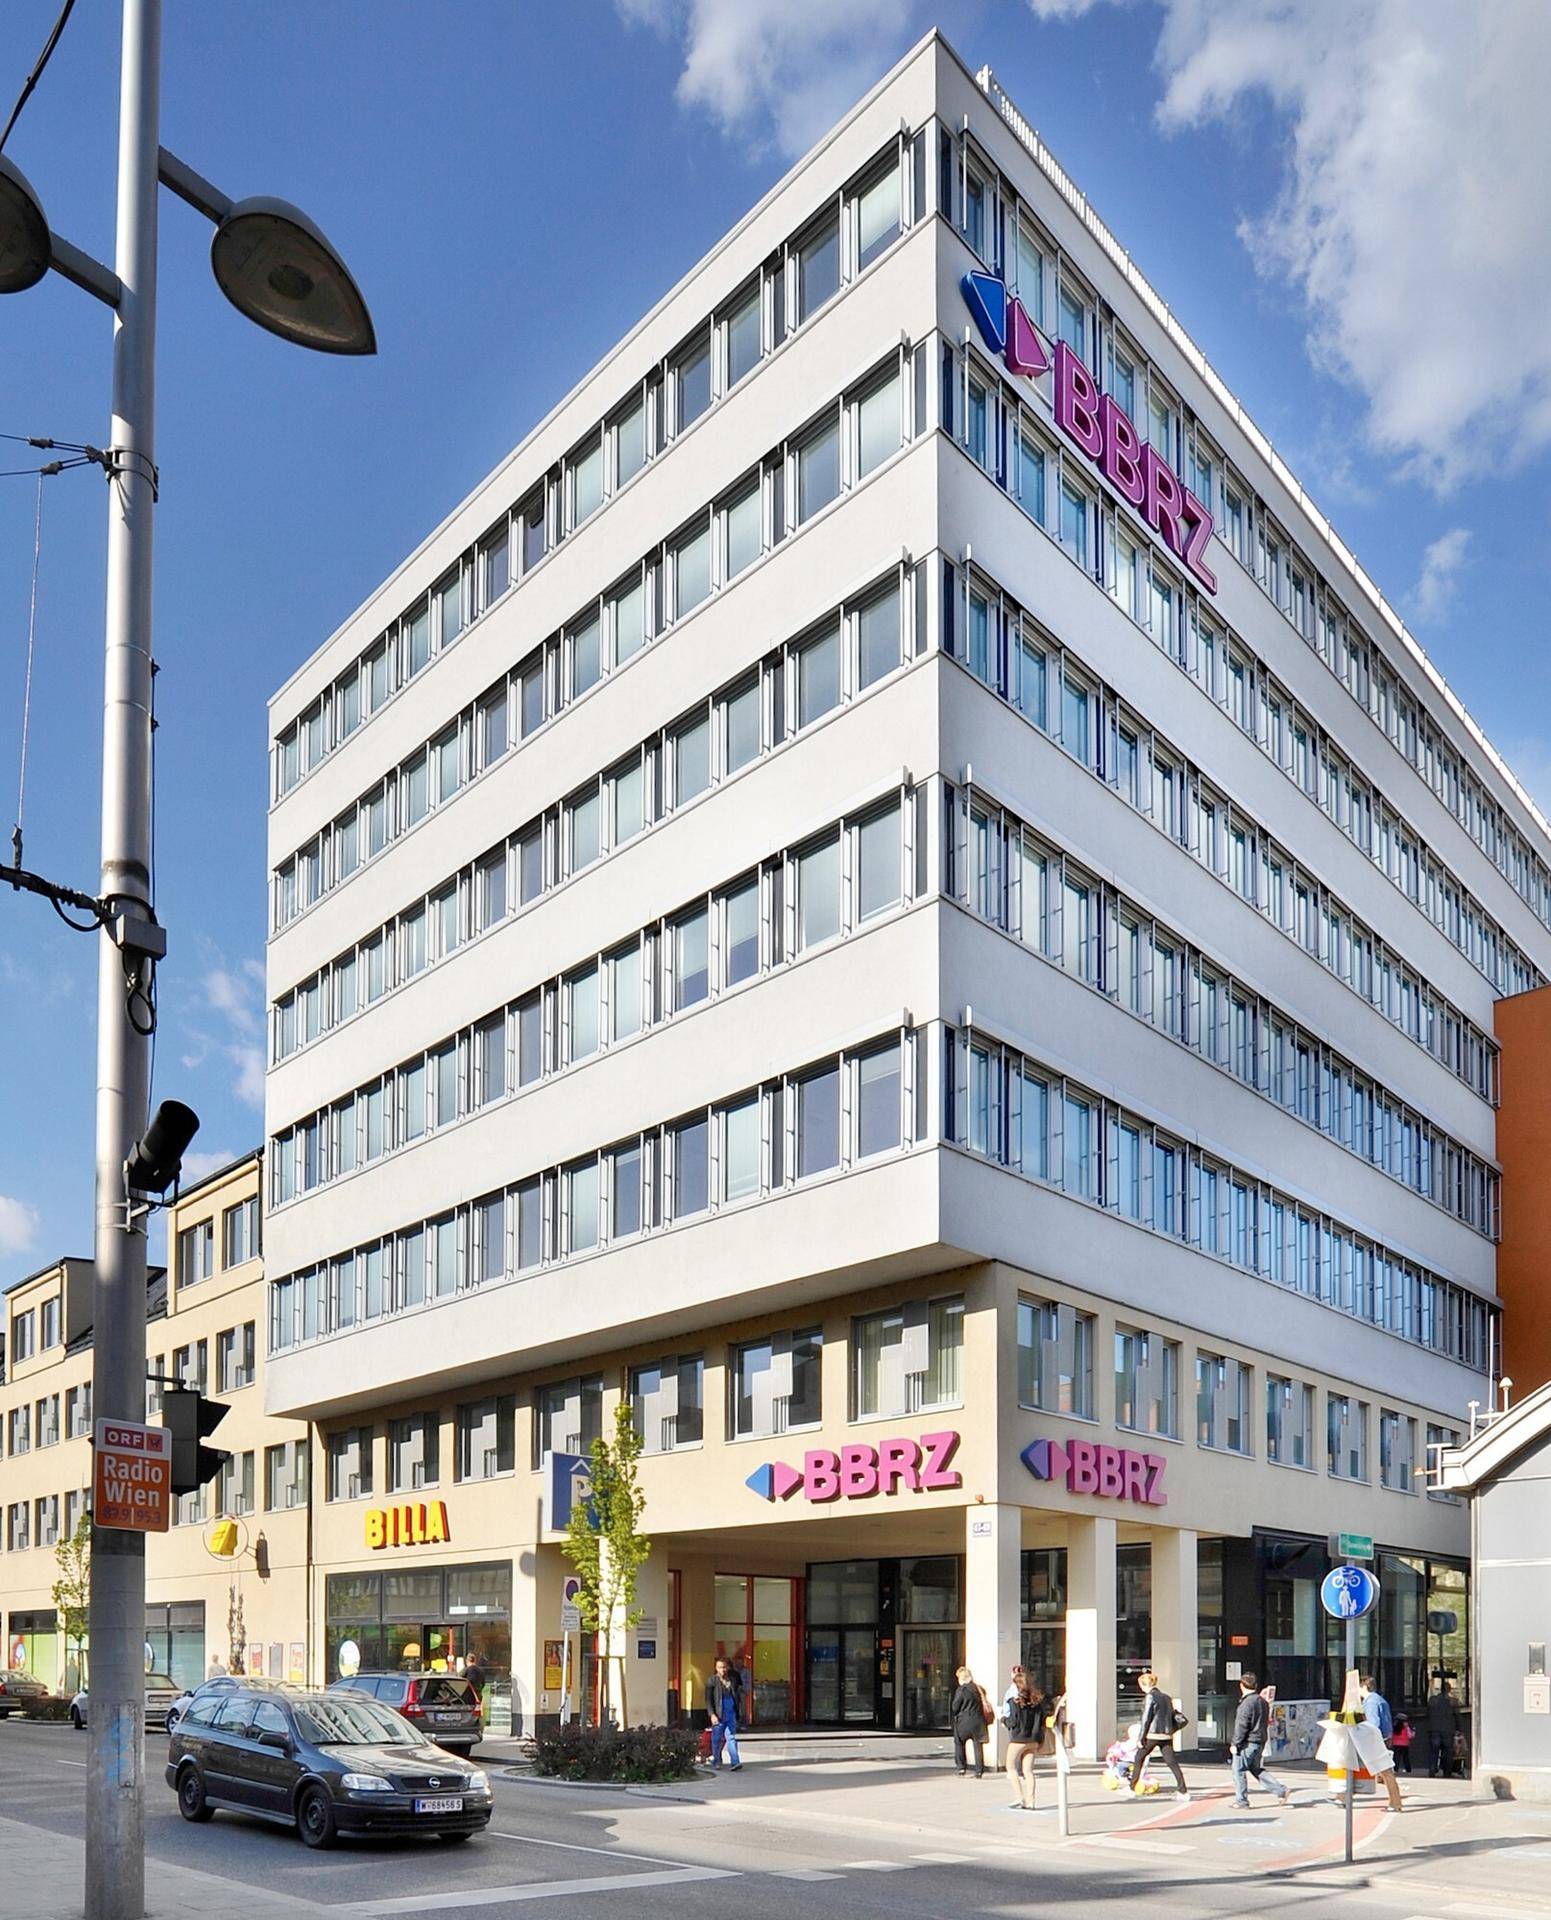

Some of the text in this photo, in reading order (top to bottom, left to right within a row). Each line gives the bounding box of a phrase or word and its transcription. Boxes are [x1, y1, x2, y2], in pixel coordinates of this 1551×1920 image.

[1054, 339, 1218, 596] BBRZ
[107, 1430, 143, 1447] ORF
[103, 1454, 163, 1484] Radio
[804, 1431, 962, 1503] BBRZ
[1066, 1439, 1168, 1506] BBRZ
[104, 1479, 160, 1508] Wien
[365, 1499, 450, 1550] BILLA
